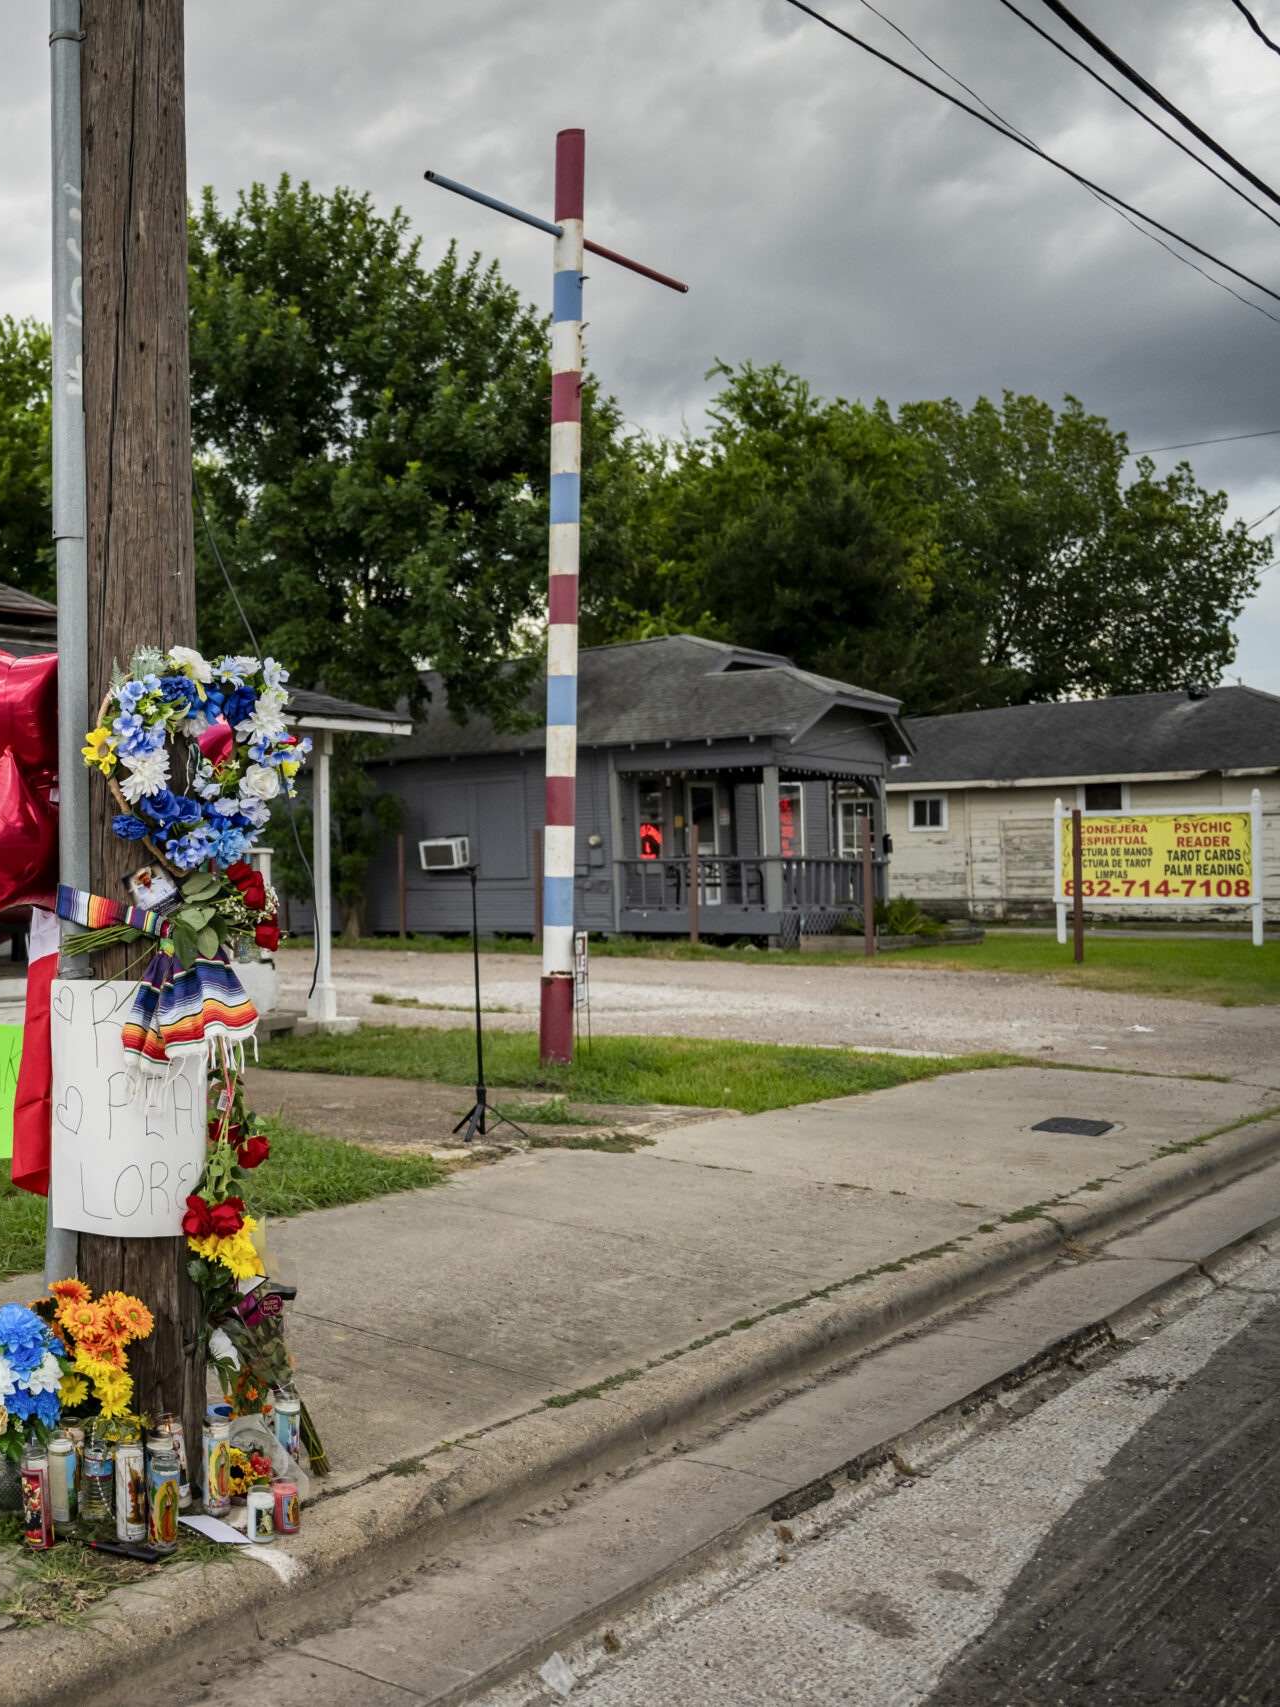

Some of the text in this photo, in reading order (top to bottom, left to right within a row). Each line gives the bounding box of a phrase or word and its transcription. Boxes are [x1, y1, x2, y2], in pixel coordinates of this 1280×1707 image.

[1081, 824, 1148, 834] CONSEJERA
[1174, 821, 1232, 833] PSYCHIC
[1081, 836, 1147, 846] ESPIRITUAL
[1177, 836, 1230, 848] READER
[1080, 847, 1153, 857] CTURA DE MANOS
[1166, 849, 1241, 861] TAROT CARDS
[1082, 858, 1152, 868] CTURA DE TAROT
[1095, 870, 1128, 879] LIMPIAS
[1164, 863, 1244, 876] PALM READING
[1064, 879, 1250, 897] 832-714-7108
